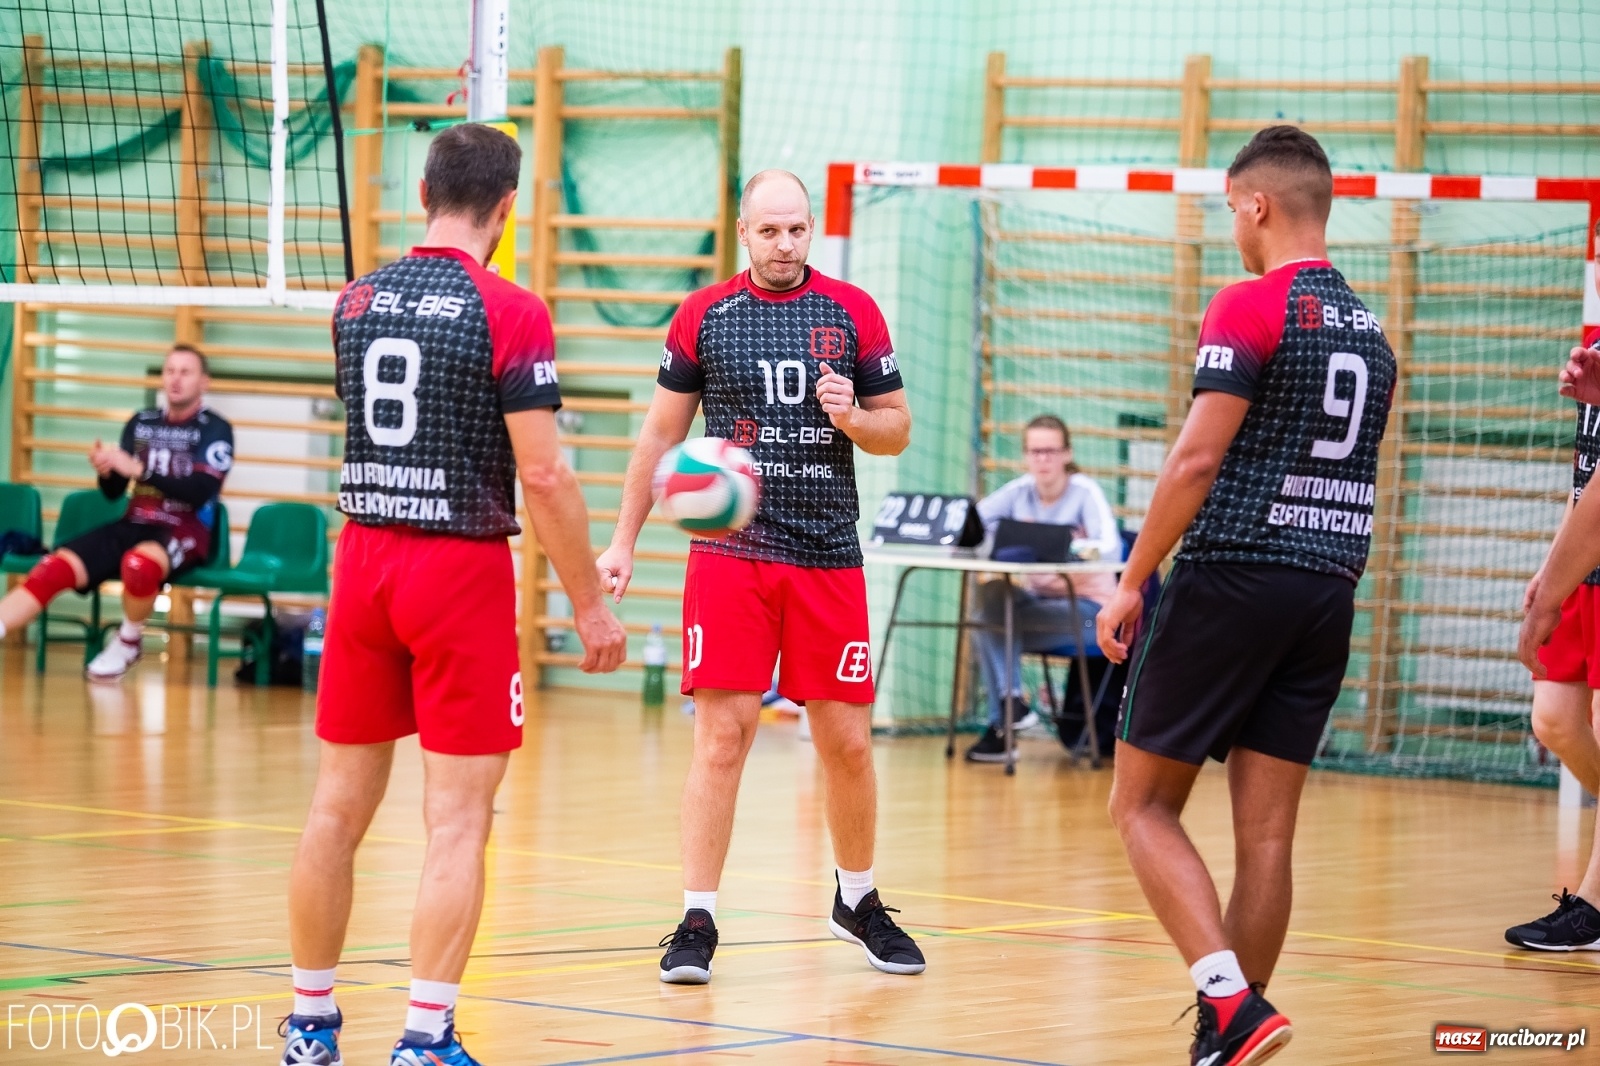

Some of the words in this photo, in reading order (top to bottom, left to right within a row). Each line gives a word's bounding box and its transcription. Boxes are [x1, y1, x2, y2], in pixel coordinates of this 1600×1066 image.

[363, 337, 422, 447] 8
[757, 360, 807, 405] 10
[1310, 352, 1368, 460] 9
[509, 671, 525, 728] 8
